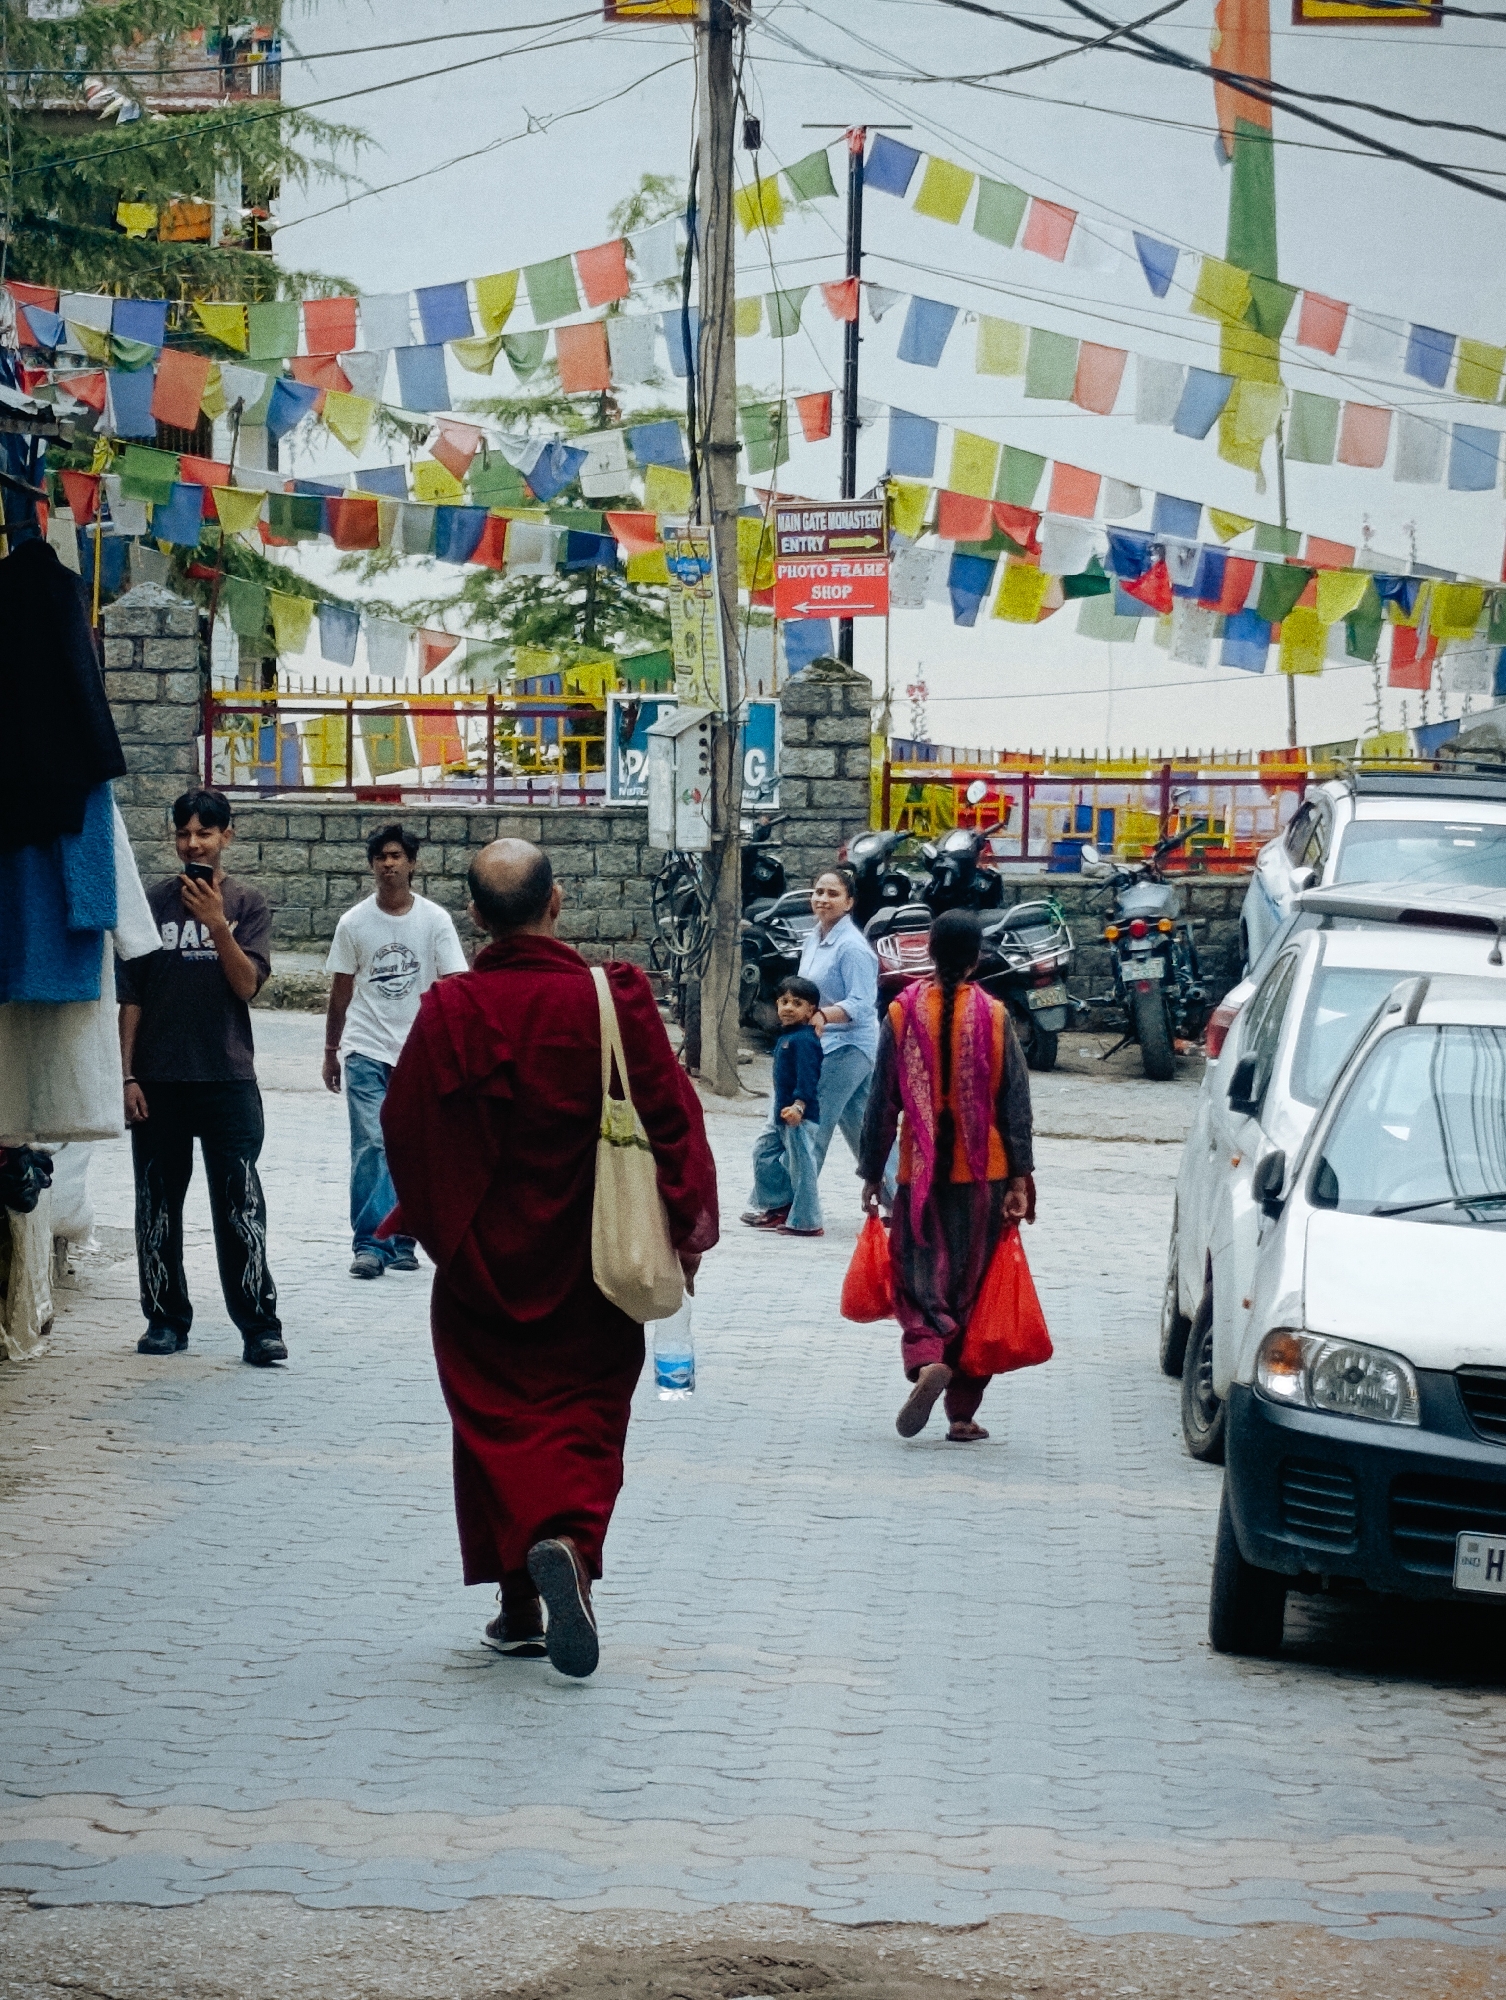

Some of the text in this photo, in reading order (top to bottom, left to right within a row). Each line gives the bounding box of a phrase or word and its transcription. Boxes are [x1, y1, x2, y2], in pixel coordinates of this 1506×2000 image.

[777, 510, 883, 532] MAIN GATE MONASTERY
[781, 536, 826, 553] ENTRY
[777, 563, 886, 579] PHOTO FRAME
[811, 585, 853, 600] SHOP
